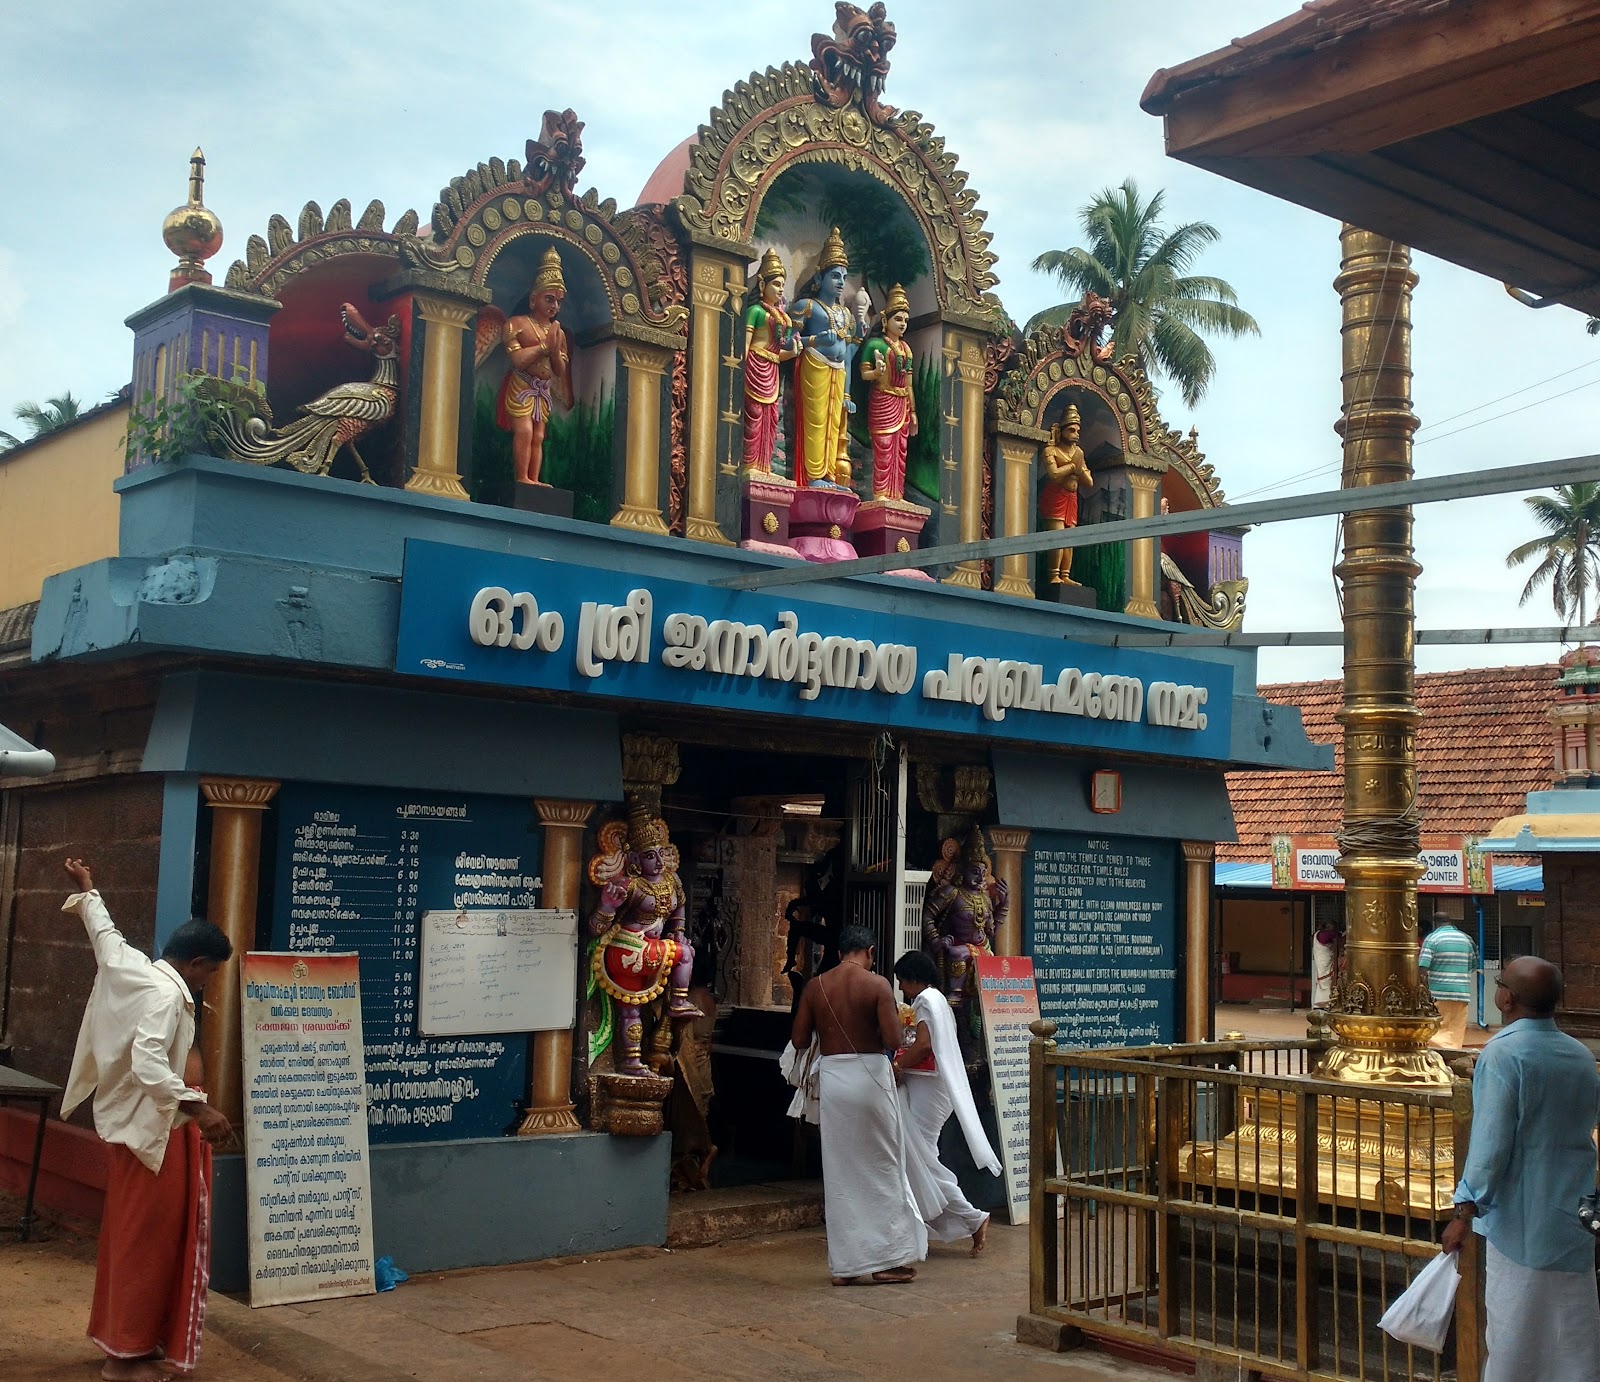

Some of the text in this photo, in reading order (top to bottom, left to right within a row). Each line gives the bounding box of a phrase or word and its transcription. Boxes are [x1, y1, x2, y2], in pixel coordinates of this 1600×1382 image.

[469, 585, 563, 652] ഓം
[576, 588, 652, 678] ശ്രീ
[1087, 840, 1109, 850] NOTICE
[1034, 851, 1053, 860] ENTRY
[1067, 852, 1077, 862] THE
[1078, 852, 1097, 863] TEMPLE
[1099, 854, 1103, 864] IS
[1126, 856, 1133, 865] TO
[1034, 862, 1048, 872] HAVE
[1059, 863, 1080, 874] RESPECT
[1081, 864, 1091, 874] FOR
[1093, 865, 1112, 876] TEMPLE
[1114, 867, 1129, 876] RULES
[1061, 875, 1066, 884] IS
[1068, 875, 1094, 886] RESTRICTED
[1115, 877, 1124, 888] THE
[1058, 887, 1083, 897] RELIGION
[1034, 898, 1051, 908] ENTER
[1052, 898, 1062, 909] THE
[1065, 898, 1084, 909] TEMPLE
[1086, 899, 1099, 909] WITH
[1034, 910, 1058, 920] DEVOTEES
[1056, 922, 1066, 931] THE
[1034, 933, 1047, 943] KEEP
[1049, 933, 1061, 943] YOUR
[1063, 933, 1078, 943] SHOES
[1101, 934, 1111, 944] THE
[1113, 934, 1130, 944] TEMPLE
[1072, 968, 1085, 979] SHALL
